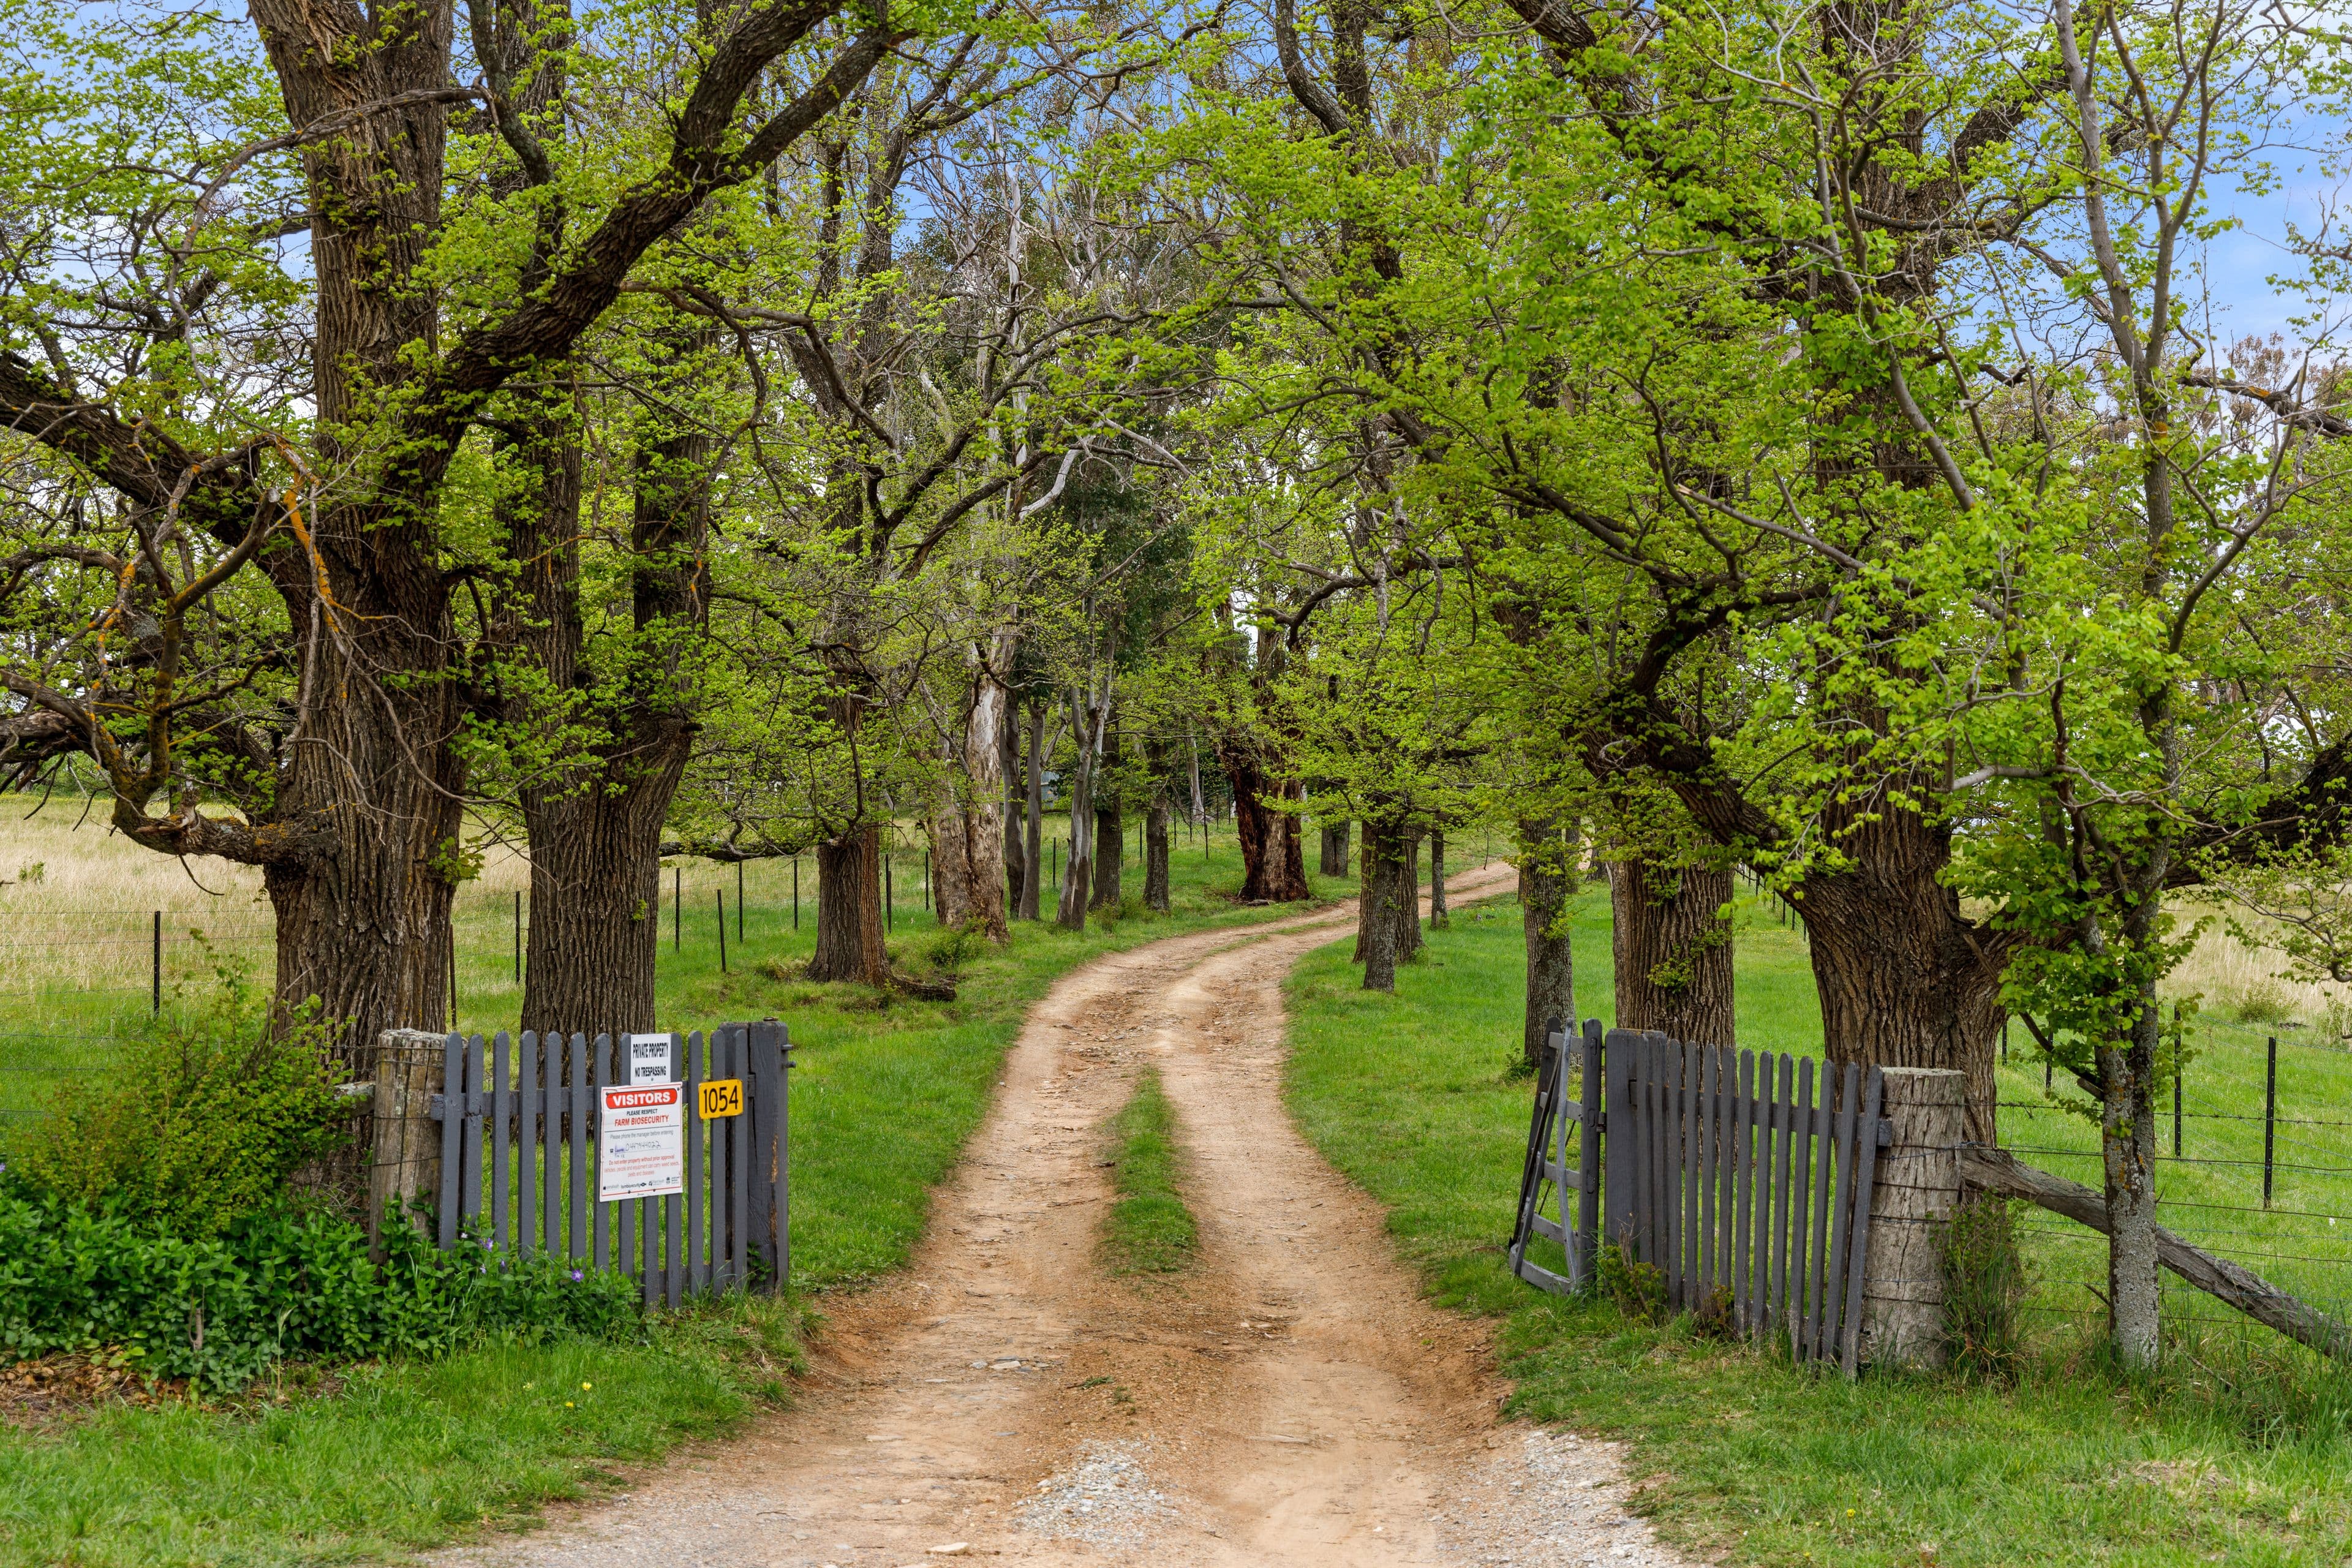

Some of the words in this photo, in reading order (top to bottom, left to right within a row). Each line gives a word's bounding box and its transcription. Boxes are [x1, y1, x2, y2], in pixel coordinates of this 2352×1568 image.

[633, 1043, 648, 1059] PRIVATE
[649, 1042, 669, 1058] PROPERTY
[635, 1067, 640, 1077] NO
[641, 1066, 666, 1077] TRESPASSING
[612, 1091, 671, 1106] VISITORS
[703, 1085, 739, 1114] 1054
[614, 1118, 630, 1126] FARM
[631, 1115, 669, 1125] BIOSECURITY
